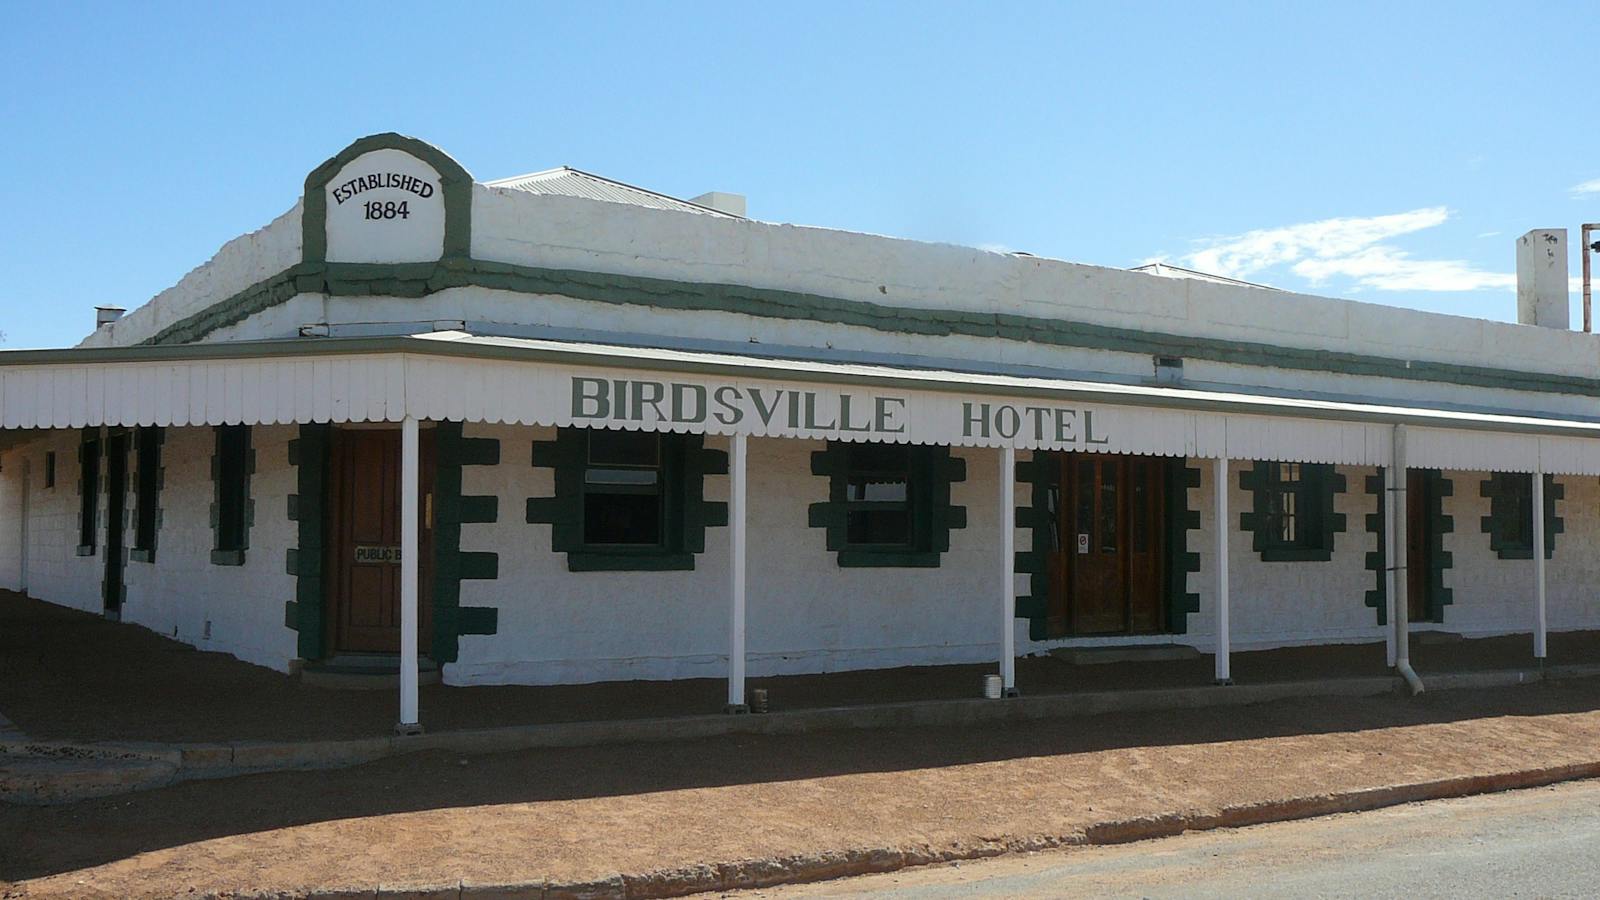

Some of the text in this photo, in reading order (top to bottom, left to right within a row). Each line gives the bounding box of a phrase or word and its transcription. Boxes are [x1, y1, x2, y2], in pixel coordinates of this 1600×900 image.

[332, 173, 434, 205] ESTABLISHED
[363, 201, 410, 220] 1884
[571, 377, 1108, 444] BIRDSVILLE HOTEL
[357, 548, 392, 560] PUBLIC
